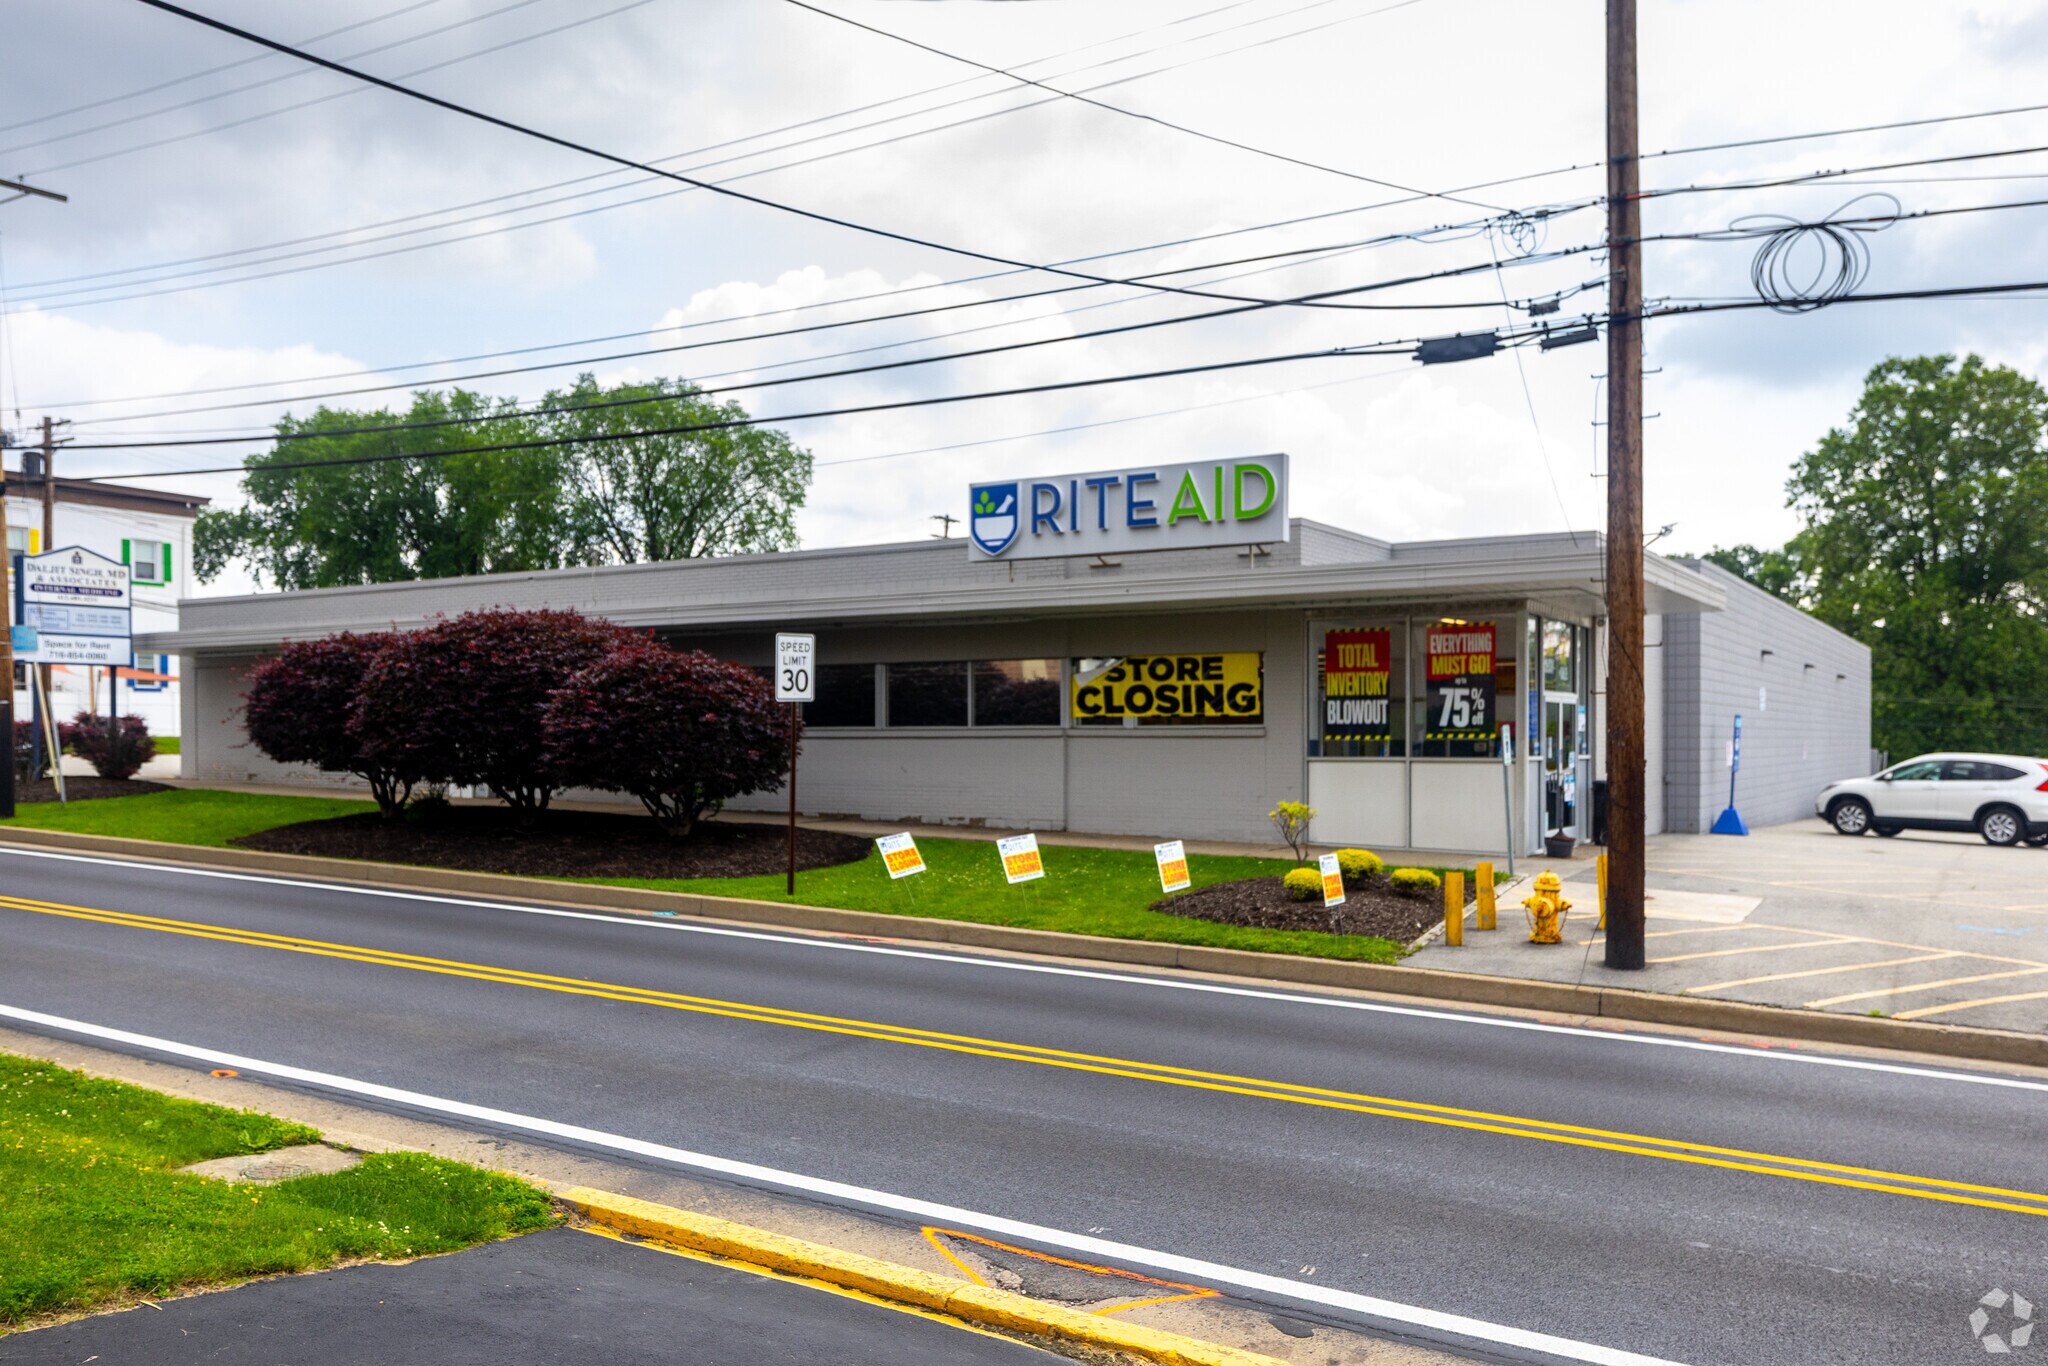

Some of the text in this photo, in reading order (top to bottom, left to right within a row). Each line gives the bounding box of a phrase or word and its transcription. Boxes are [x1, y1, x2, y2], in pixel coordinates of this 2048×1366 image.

[1031, 463, 1277, 535] RITE AID
[49, 575, 117, 586] ASSOCIATES
[108, 569, 126, 578] MD
[33, 584, 118, 596] INTERNAL MEDICINE
[44, 640, 112, 650] Space for Rent
[780, 642, 811, 653] SPEED
[1430, 632, 1492, 654] EVERYTHING
[783, 655, 807, 666] LIMIT
[1337, 643, 1380, 668] TOTAL
[1432, 654, 1491, 675] MUST GO!
[782, 668, 809, 692] 30
[1326, 671, 1389, 697] INVENTORY
[1076, 683, 1257, 714] CLOSING
[1327, 699, 1389, 725] BLOWOUT
[1471, 711, 1484, 726] off
